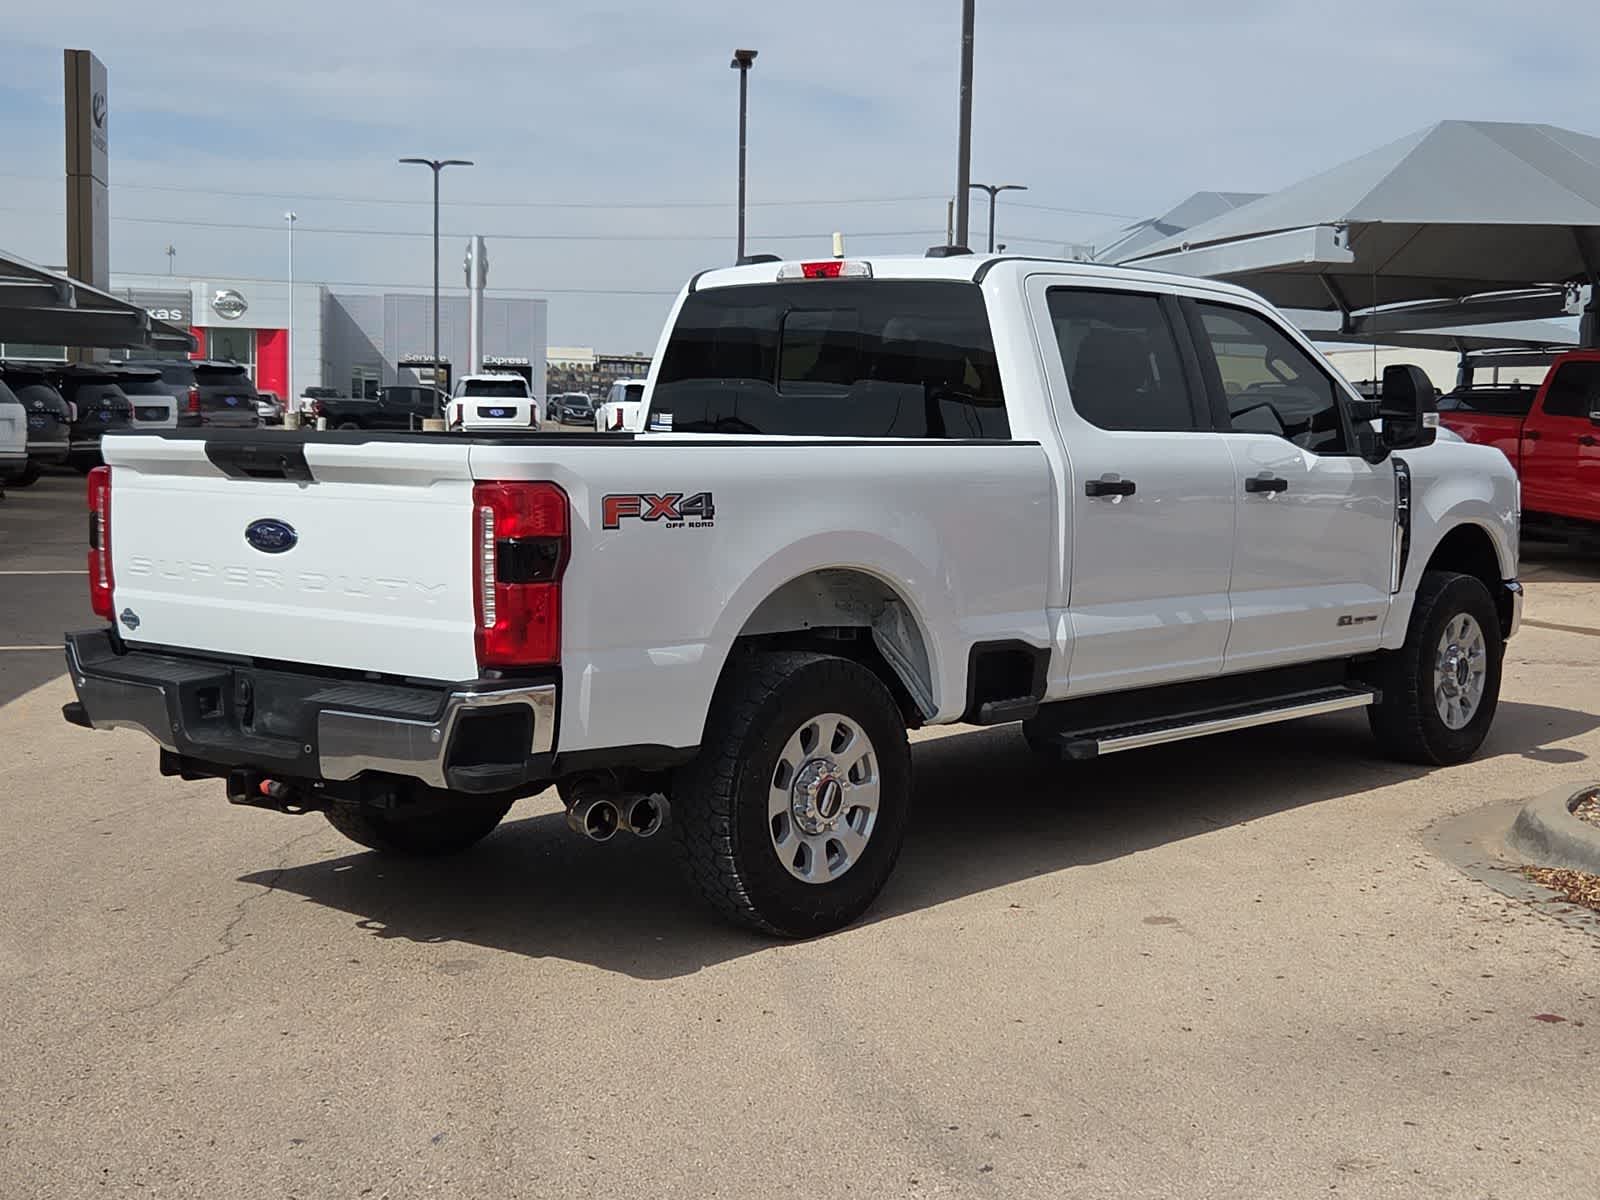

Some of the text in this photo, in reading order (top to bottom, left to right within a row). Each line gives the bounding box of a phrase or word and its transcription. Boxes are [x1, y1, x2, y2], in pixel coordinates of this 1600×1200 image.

[405, 353, 448, 362] Servie
[482, 354, 528, 365] Express
[602, 492, 715, 530] FX4
[128, 552, 448, 607] SUPER DUTY
